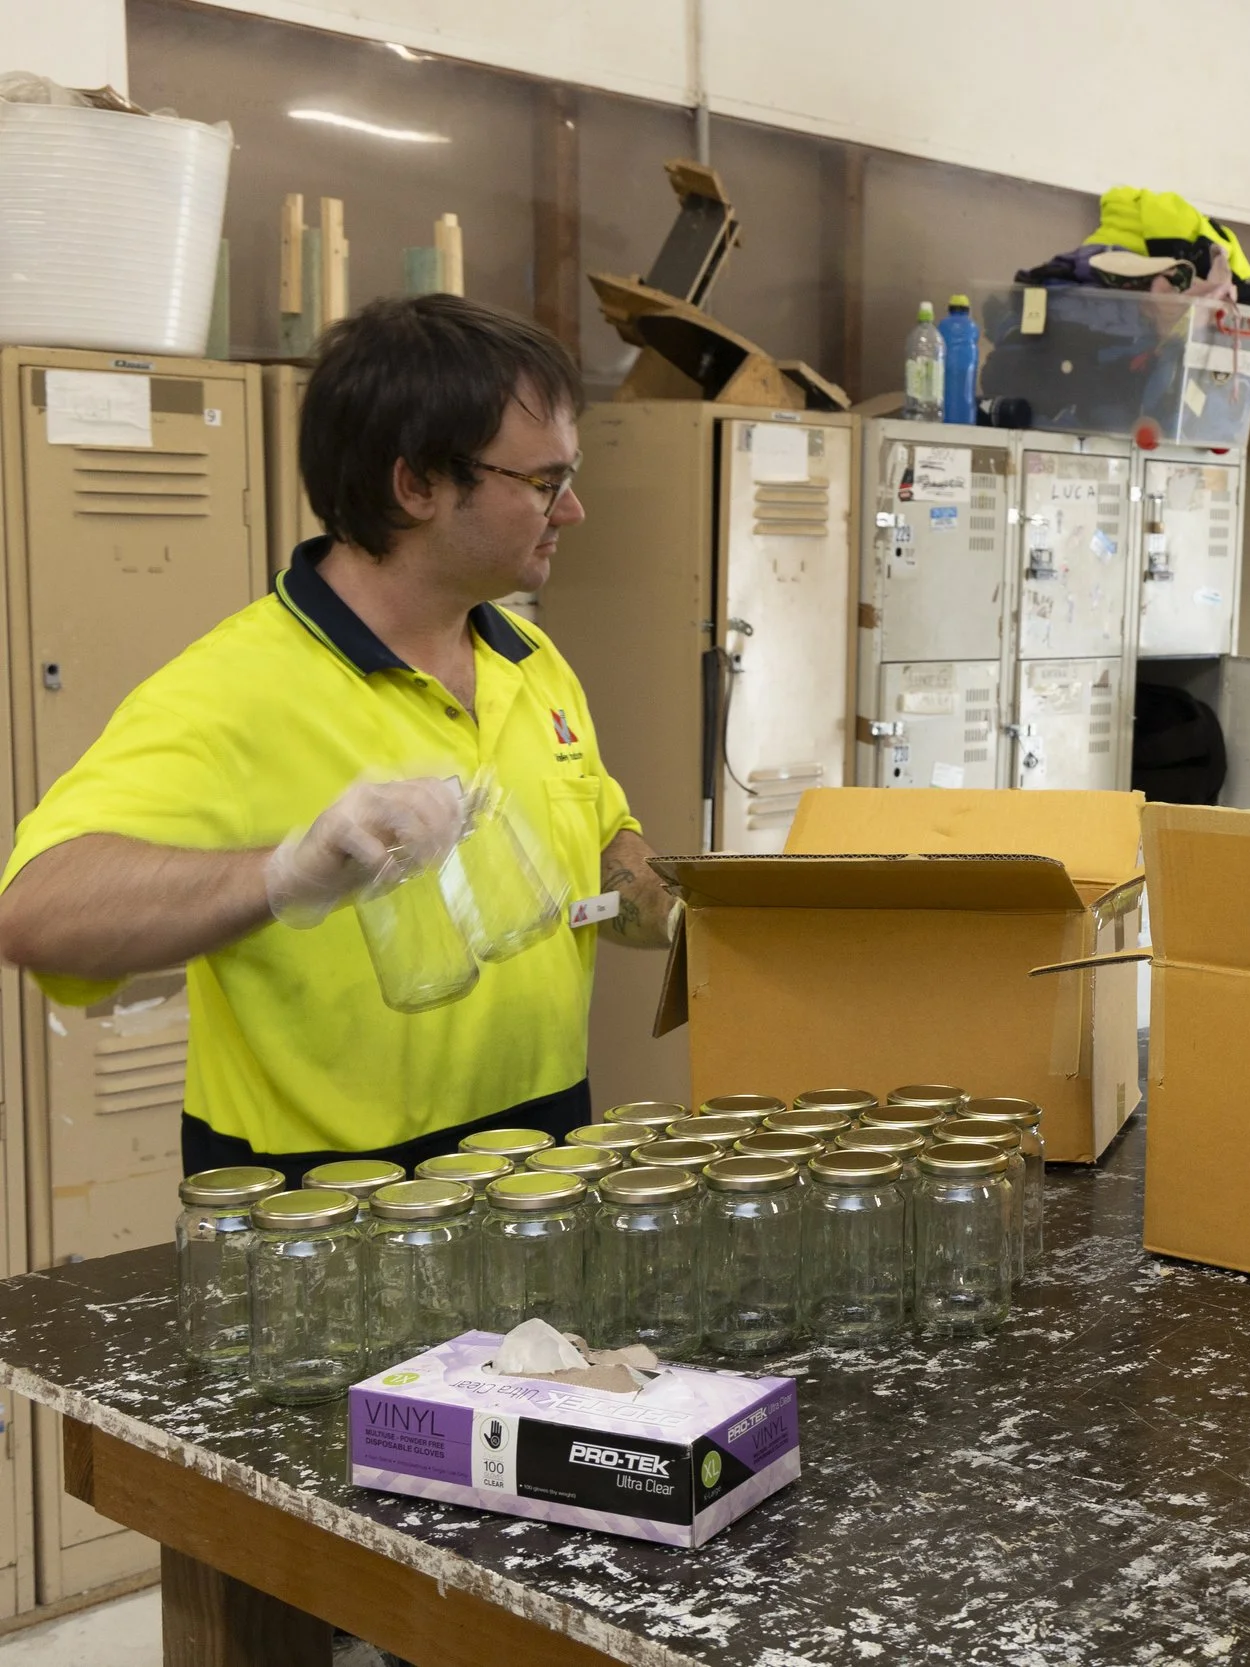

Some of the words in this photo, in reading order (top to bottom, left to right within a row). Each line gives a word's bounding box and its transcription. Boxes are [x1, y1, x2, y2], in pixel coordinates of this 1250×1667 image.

[1052, 484, 1096, 500] LUCA
[449, 1380, 496, 1394] Clear
[497, 1385, 540, 1400] Ultra
[365, 1399, 445, 1438] VINYL
[728, 1407, 768, 1444] PRO-TEK
[365, 1428, 396, 1442] MULTIUSE
[400, 1435, 428, 1447] POWDER
[428, 1440, 445, 1451] FREE
[752, 1415, 788, 1449] VINYL
[365, 1437, 413, 1454] DISPOSABLE
[413, 1446, 445, 1459] GLOVES
[483, 1460, 505, 1475] 100
[569, 1443, 671, 1477] PRO-TEK
[704, 1459, 720, 1482] XL
[484, 1478, 504, 1488] CLEAR
[617, 1474, 643, 1491] Ultra
[645, 1479, 675, 1496] Clear
